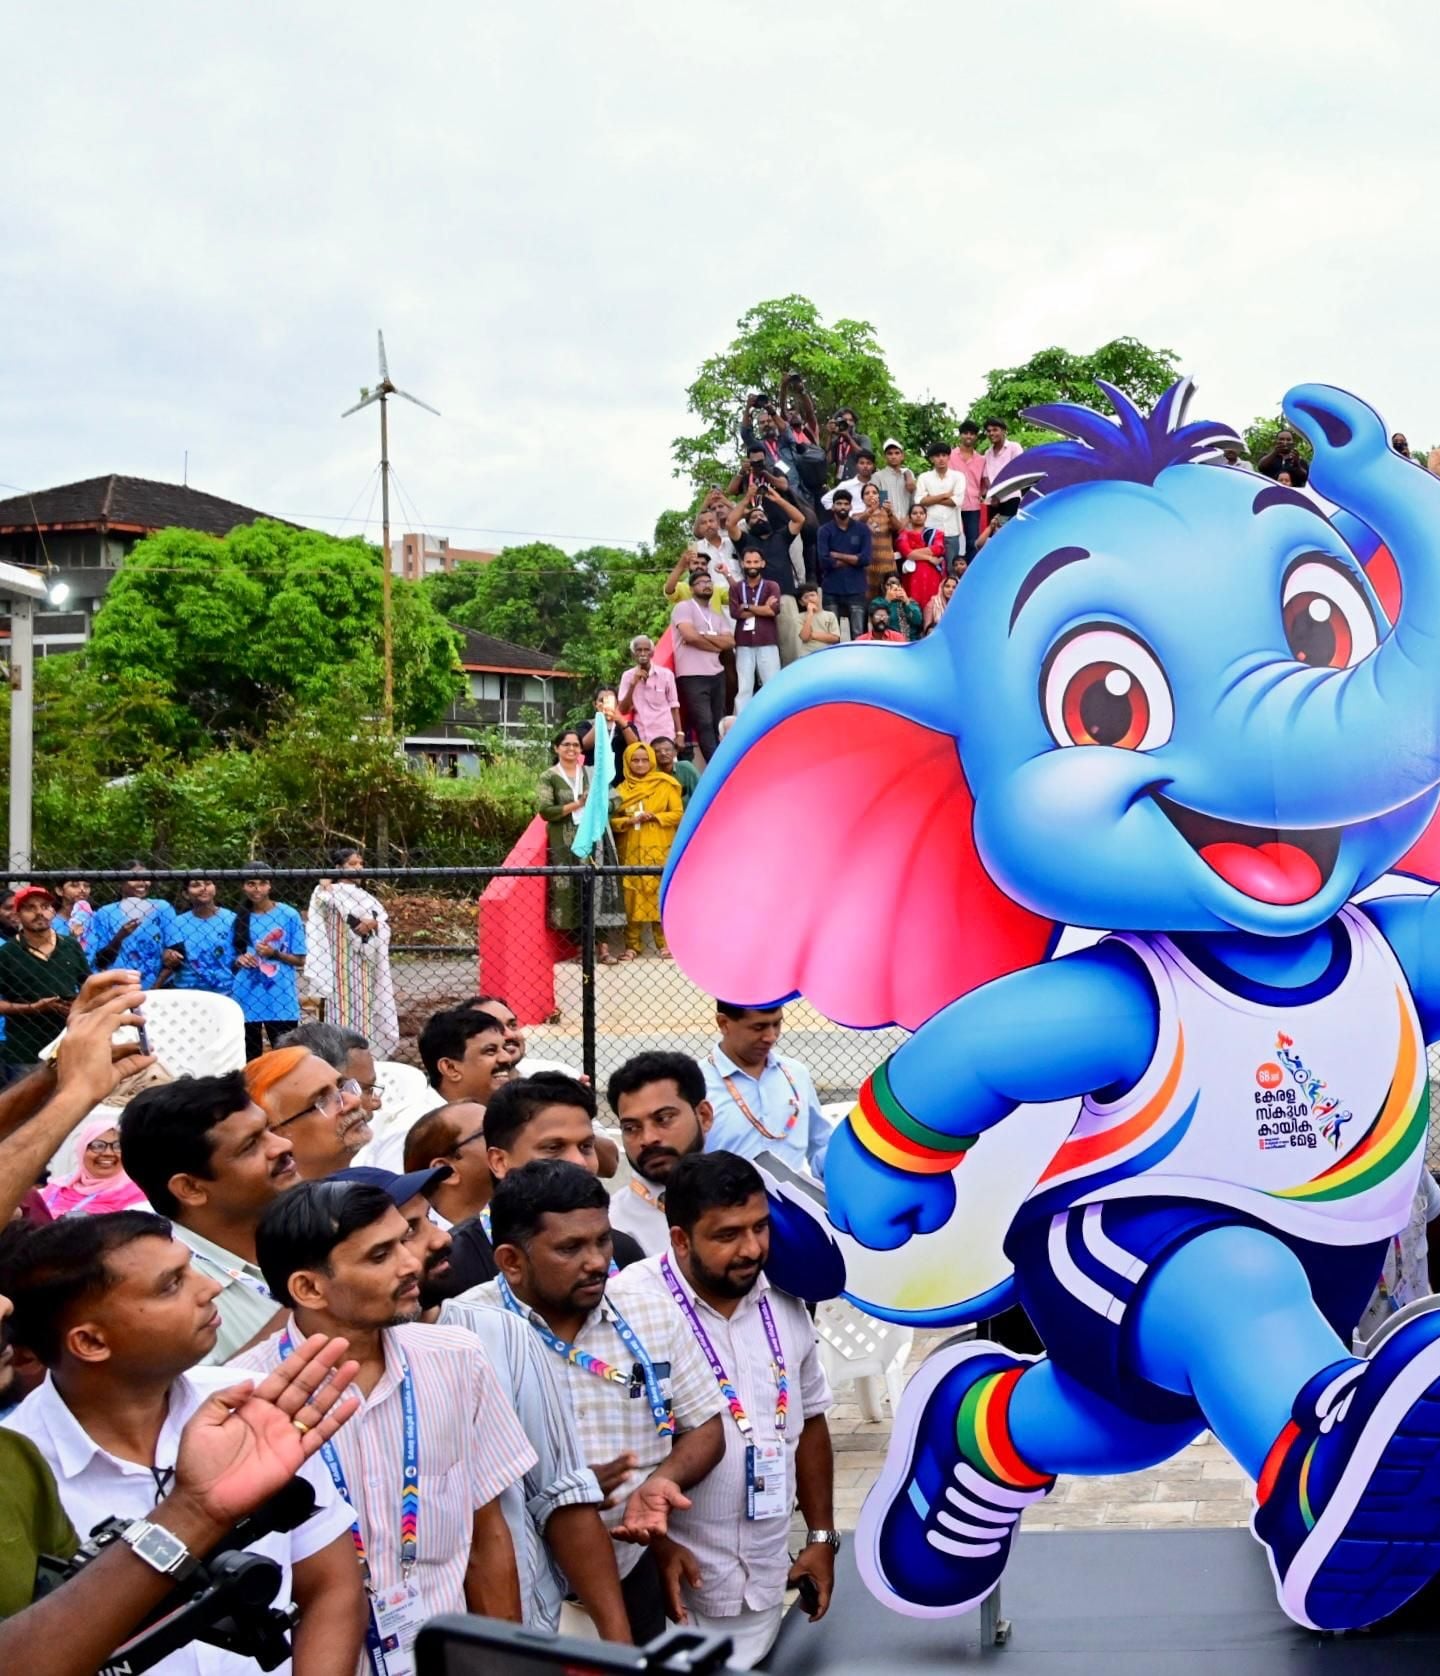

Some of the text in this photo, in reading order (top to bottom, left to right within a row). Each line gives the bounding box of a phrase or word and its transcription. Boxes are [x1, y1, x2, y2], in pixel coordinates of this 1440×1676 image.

[1254, 1089, 1296, 1104] കേരള
[1258, 1118, 1313, 1137] കായിക
[1290, 1133, 1317, 1149] മേള
